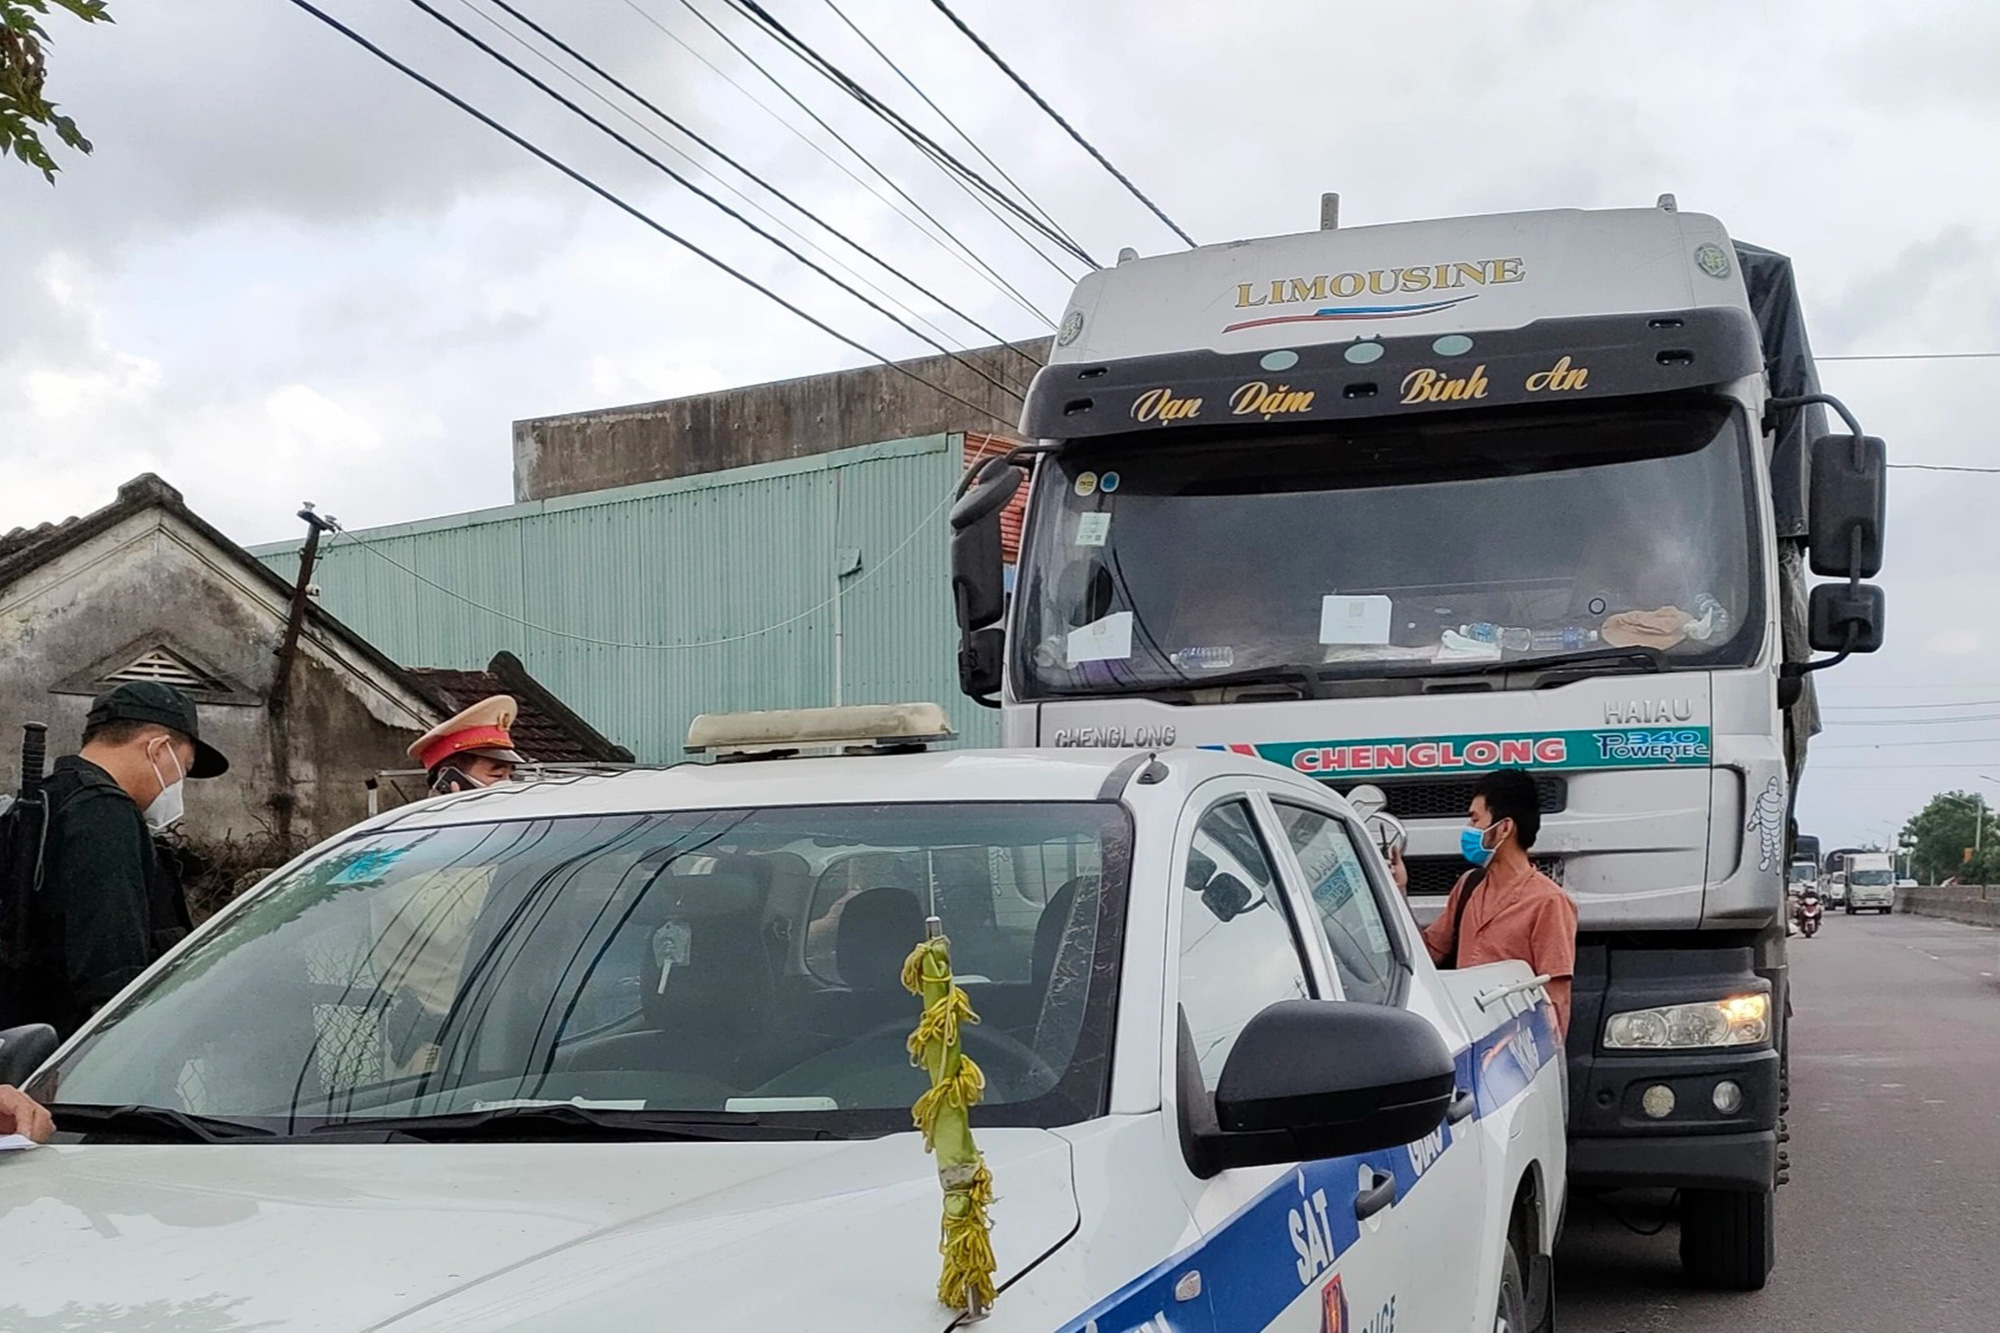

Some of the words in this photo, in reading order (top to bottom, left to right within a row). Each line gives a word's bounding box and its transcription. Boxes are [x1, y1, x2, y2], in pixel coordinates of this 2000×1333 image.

[1235, 257, 1526, 308] LIMOUSINE
[1130, 388, 1203, 426] Vạn
[1229, 381, 1315, 420] Dặm
[1399, 364, 1489, 404] Bình
[1525, 355, 1589, 392] An
[1055, 725, 1176, 748] CHENGLONG
[1292, 738, 1567, 773] CHENGLONG
[1627, 731, 1701, 745] 340
[1288, 1167, 1335, 1286] SÁT
